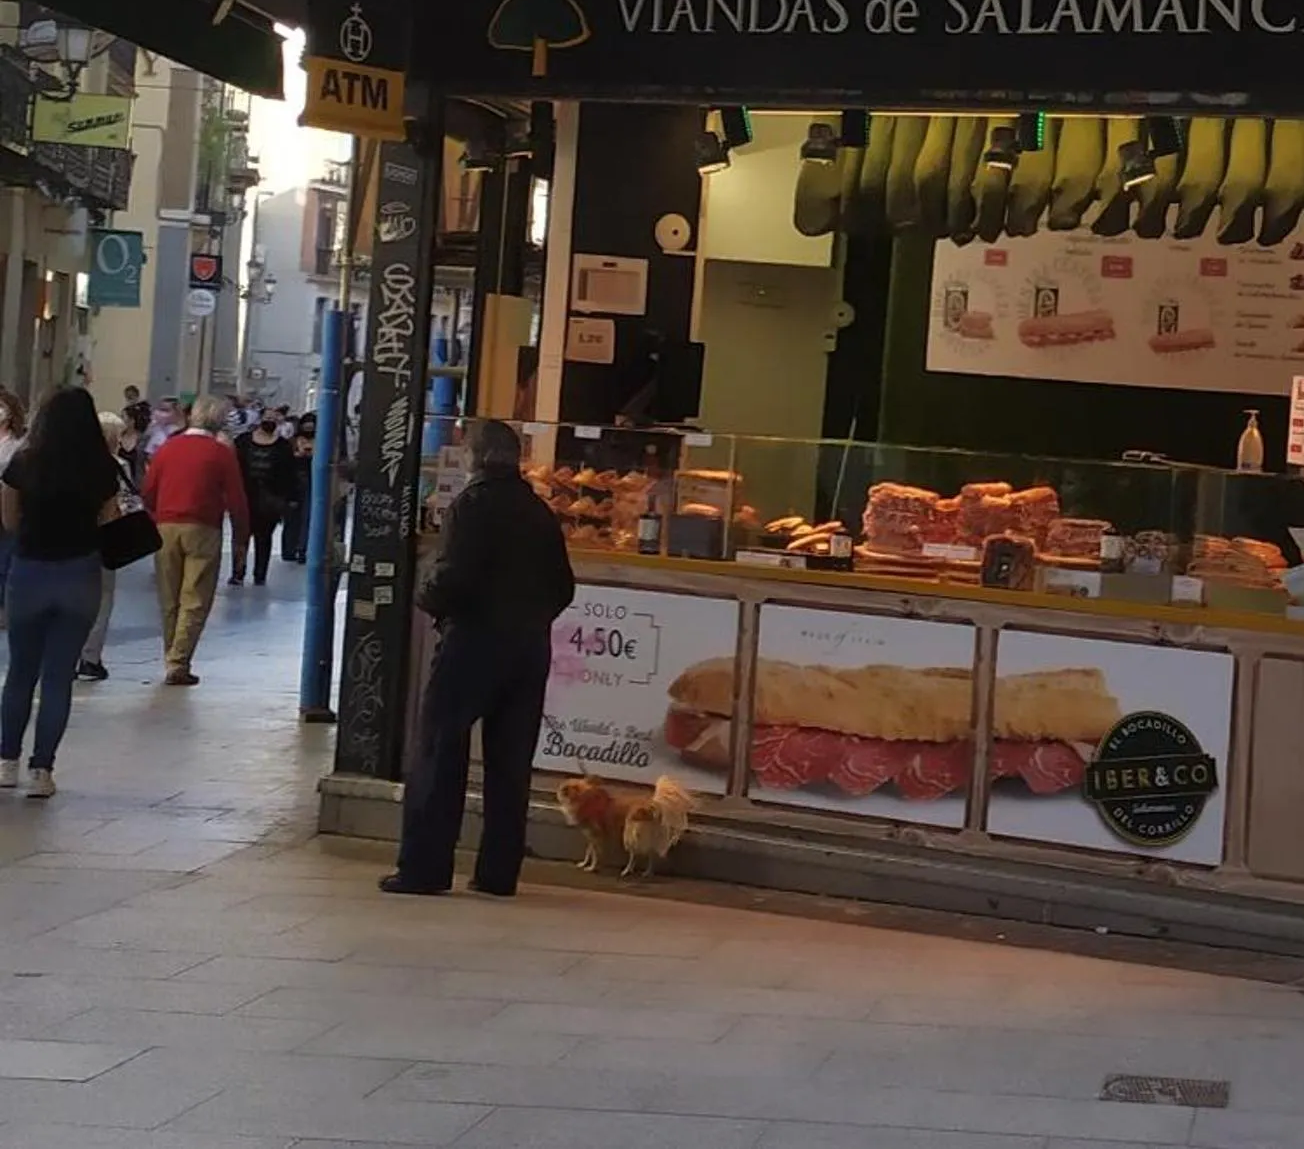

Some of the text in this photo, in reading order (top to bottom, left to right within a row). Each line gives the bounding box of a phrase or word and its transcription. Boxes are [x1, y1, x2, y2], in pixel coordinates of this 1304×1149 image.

[320, 68, 388, 111] ATM
[584, 602, 627, 620] SOLO
[569, 626, 639, 660] 4,50€
[582, 669, 624, 686] ONLY
[542, 730, 650, 768] Bocadillo
